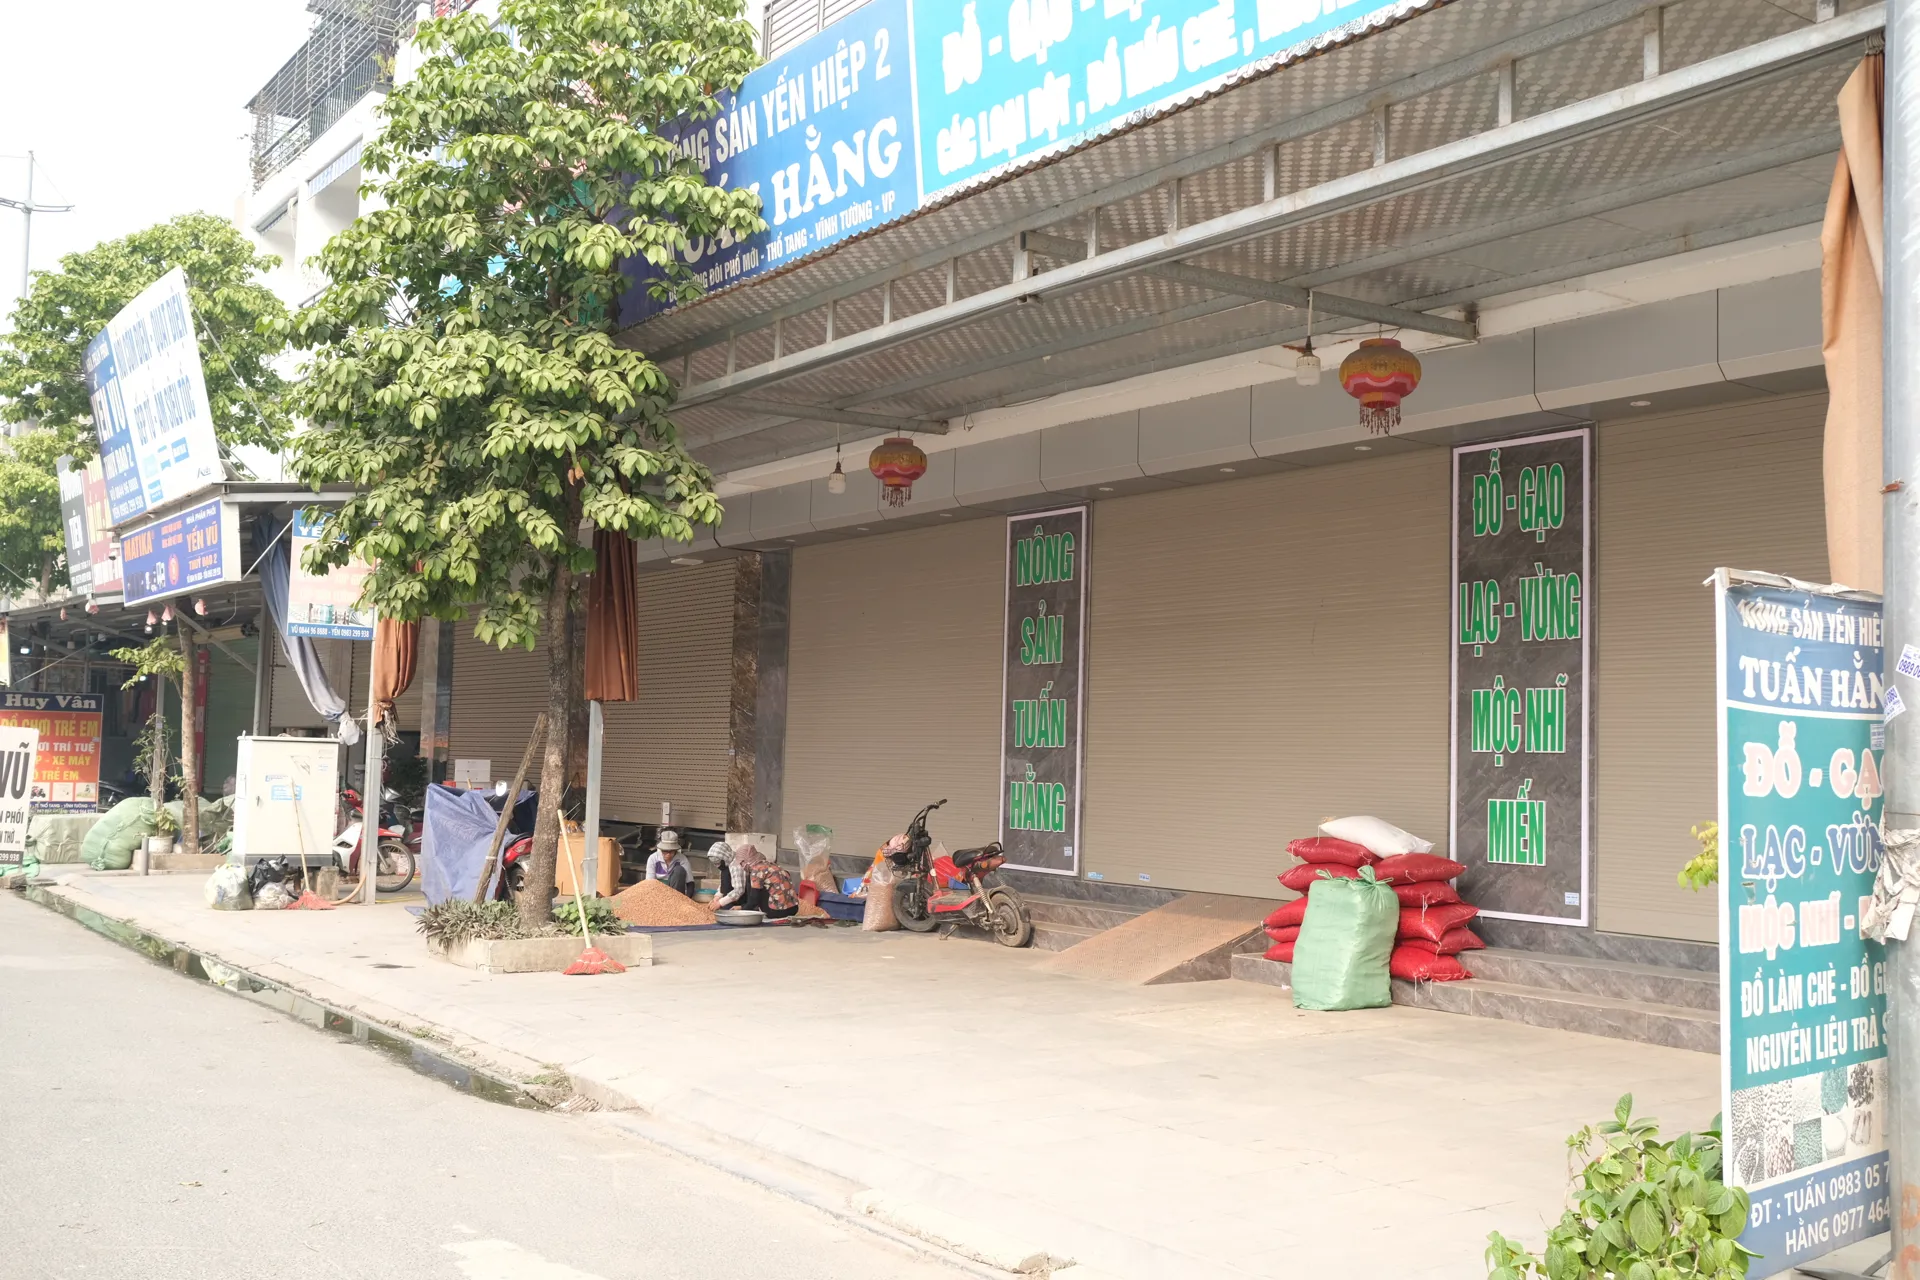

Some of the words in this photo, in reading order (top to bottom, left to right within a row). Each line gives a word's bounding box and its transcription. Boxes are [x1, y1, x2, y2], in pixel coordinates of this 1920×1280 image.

[715, 96, 758, 163] SẢN
[761, 66, 807, 138] YẾN
[811, 38, 866, 114] HIỆP
[874, 27, 891, 82] 2
[771, 116, 902, 226] HẰNG
[724, 249, 741, 280] PHỐ
[742, 247, 760, 272] MỚI
[784, 228, 808, 254] TANG
[881, 190, 896, 214] VP
[1472, 448, 1503, 538] ĐỖ
[1518, 462, 1565, 543] GẠO
[186, 525, 204, 553] YẾN
[205, 520, 218, 546] VŨ
[1016, 525, 1075, 587] NÔNG
[1020, 599, 1064, 666] SẢN
[1459, 577, 1501, 657] LẠC
[1519, 562, 1581, 643] VỪNG
[1737, 597, 1789, 636] NÔNG
[1790, 599, 1824, 641] SẢN
[1826, 605, 1856, 645] YẾN
[1859, 611, 1884, 654] HIỆ
[5, 694, 49, 709] Huy
[56, 695, 97, 709] Vân
[1739, 645, 1824, 706] TUẤN
[54, 712, 76, 736] TRẺ
[79, 720, 98, 738] EM
[1012, 680, 1067, 748] TUẤN
[1472, 675, 1521, 767] MỘC
[1525, 673, 1569, 754] NHĨ
[41, 766, 60, 780] TRẺ
[63, 771, 79, 781] EM
[52, 756, 65, 765] XE
[68, 755, 91, 766] MÁY
[53, 741, 71, 752] TRÍ
[74, 741, 95, 754] TUỆ
[1743, 720, 1802, 799] ĐỖ
[1829, 747, 1885, 810] GẠ
[5, 807, 24, 824] PHỐI
[1009, 763, 1066, 833] HẰNG
[1487, 778, 1546, 867] MIẾN
[1740, 824, 1806, 893] LẠC
[1739, 894, 1796, 960] MỘC
[1741, 967, 1764, 1018] ĐỒ
[1768, 969, 1803, 1014] LÀM
[1807, 962, 1837, 1007] CHÈ
[1850, 952, 1870, 1000] ĐỒ
[1746, 1021, 1812, 1075] NGUYÊN
[1815, 1014, 1848, 1065] LIỆU
[1851, 1008, 1879, 1052] TRÀ
[1751, 1198, 1773, 1228] ĐT
[1784, 1177, 1826, 1216] TUẤN
[1829, 1170, 1861, 1201] 0983
[1864, 1164, 1880, 1189] 05
[1785, 1217, 1829, 1255] HẰNG
[1832, 1205, 1865, 1238] 0977
[1867, 1196, 1890, 1223] 464
